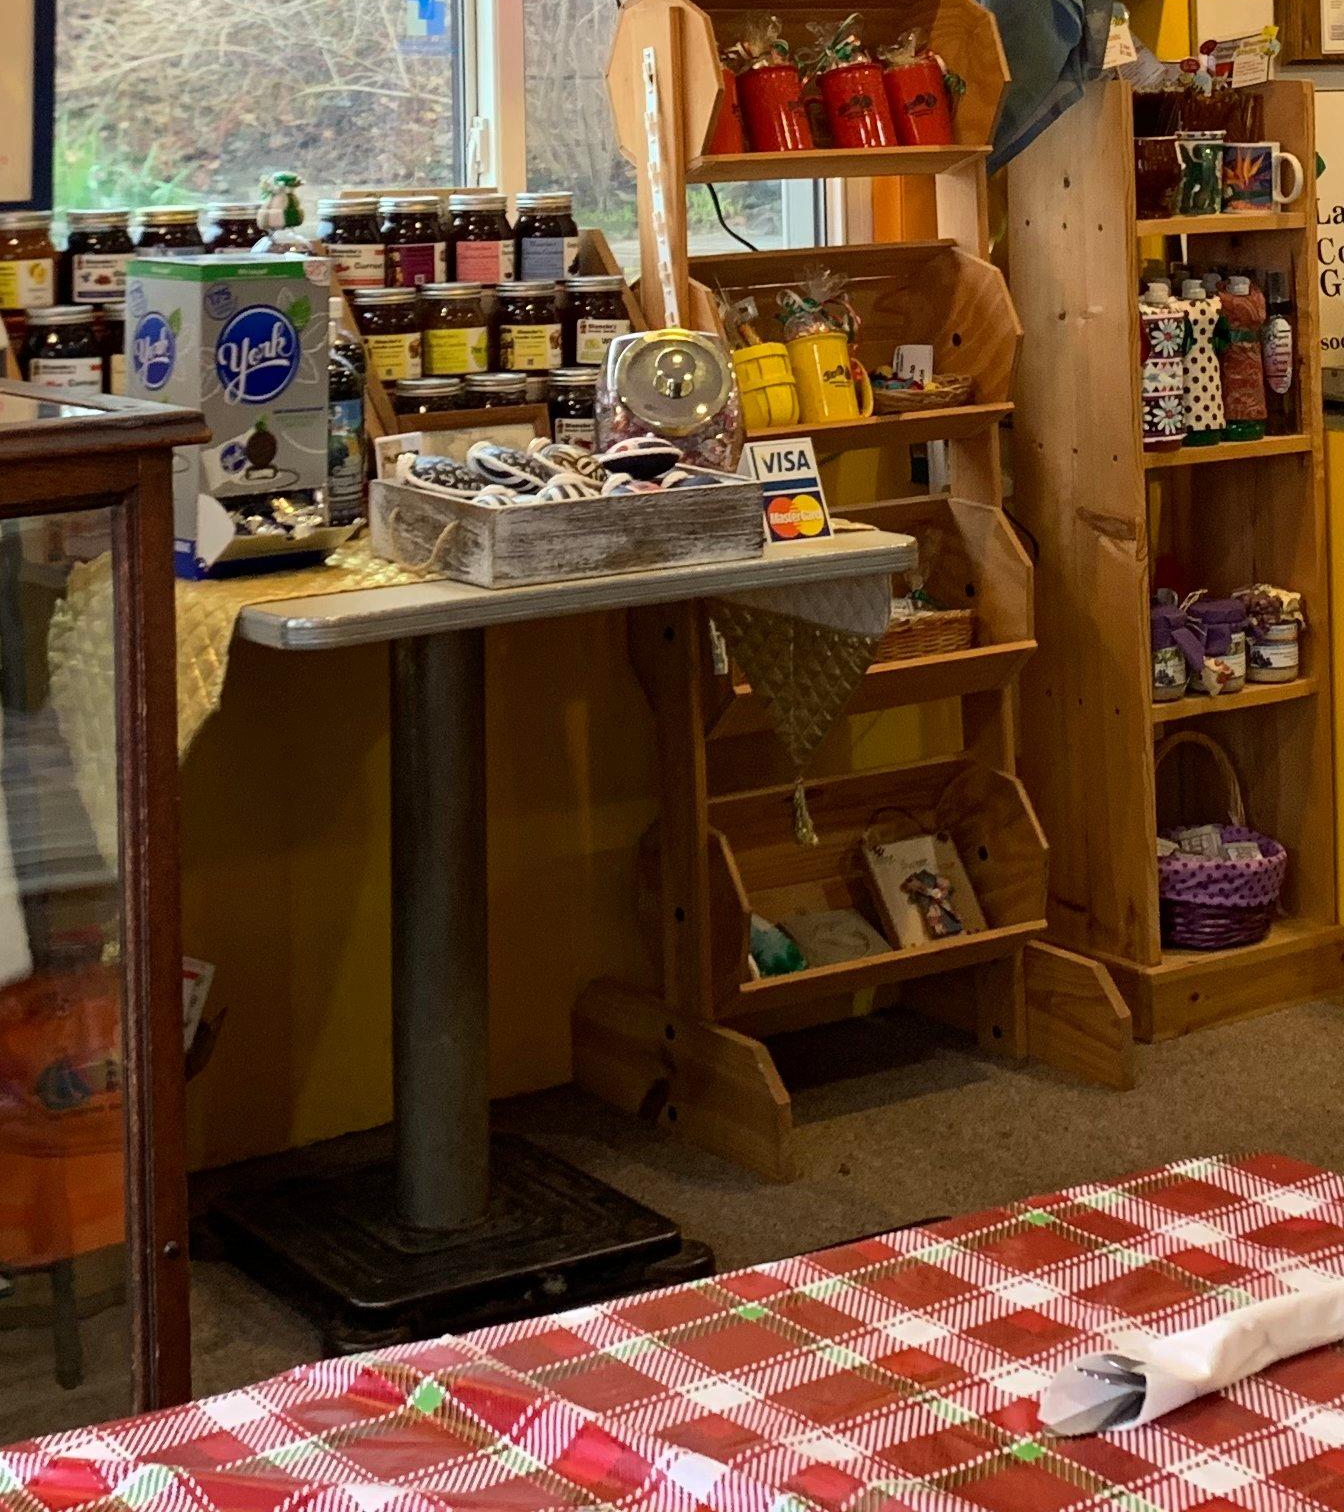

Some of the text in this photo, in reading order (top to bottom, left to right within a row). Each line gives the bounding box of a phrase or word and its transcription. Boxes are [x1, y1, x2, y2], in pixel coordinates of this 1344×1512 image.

[218, 321, 290, 407] York
[762, 449, 812, 475] VISA
[769, 508, 825, 526] MasterCard
